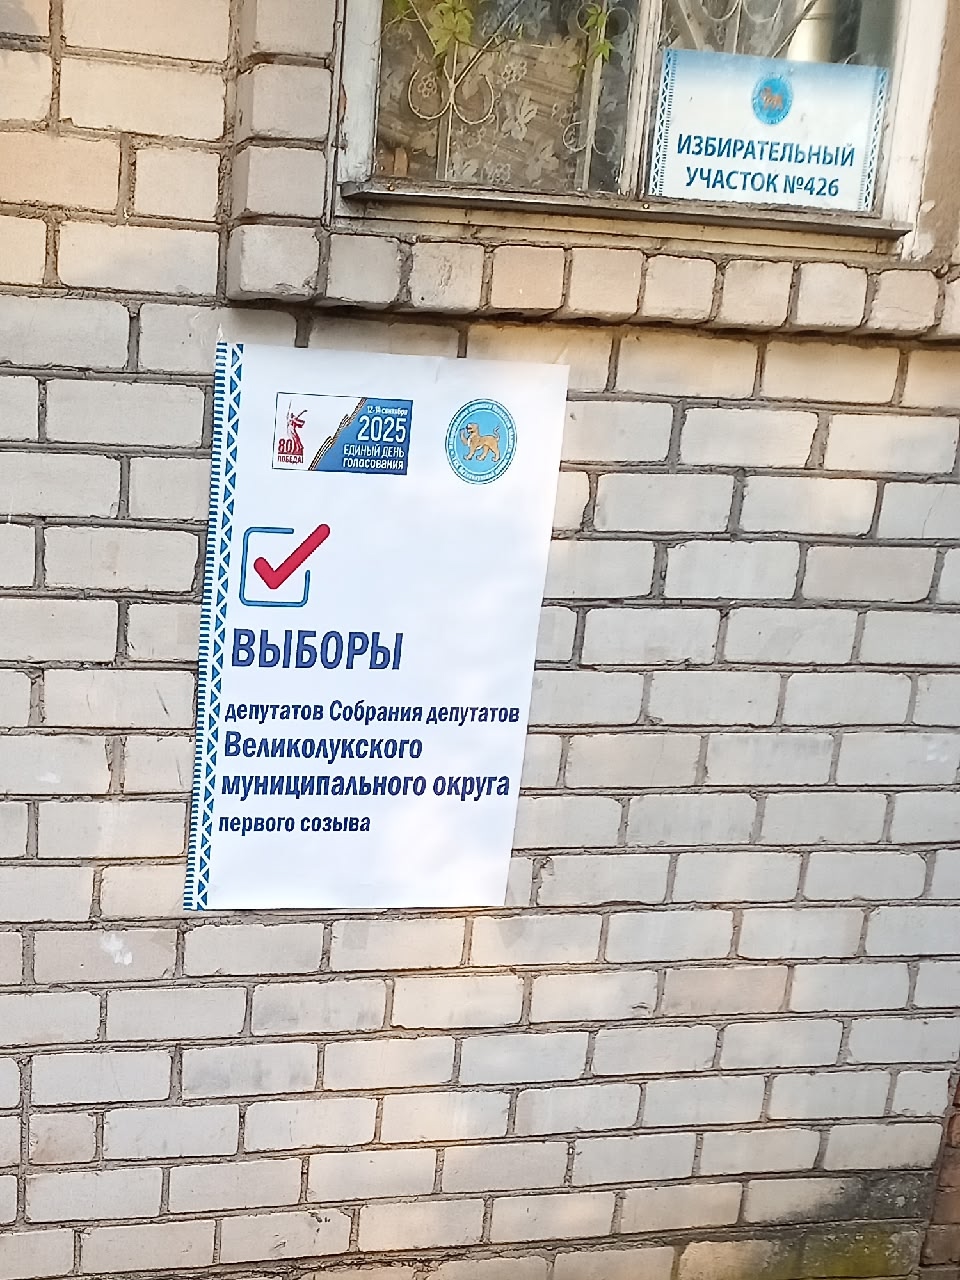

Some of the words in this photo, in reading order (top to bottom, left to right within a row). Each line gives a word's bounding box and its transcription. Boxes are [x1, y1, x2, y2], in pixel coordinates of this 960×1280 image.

[677, 134, 856, 167] ИЗБИРАТЕЛЬНЫЙ
[685, 166, 779, 194] УЧАСТОК
[783, 174, 840, 197] №426
[358, 416, 406, 443] 2025
[278, 438, 293, 453] 80
[343, 443, 380, 457] ЕДИНЫЙ
[381, 446, 405, 459] ДЕНЬ
[231, 628, 403, 671] ВЫБОРЫ
[224, 700, 324, 724] депутатов
[328, 700, 423, 726] Собрания
[425, 703, 520, 726] депутатов
[224, 731, 423, 764] Великолукского
[221, 774, 427, 801] муниципального
[433, 774, 510, 802] округа
[218, 813, 296, 835] первого
[299, 815, 371, 834] созыва
